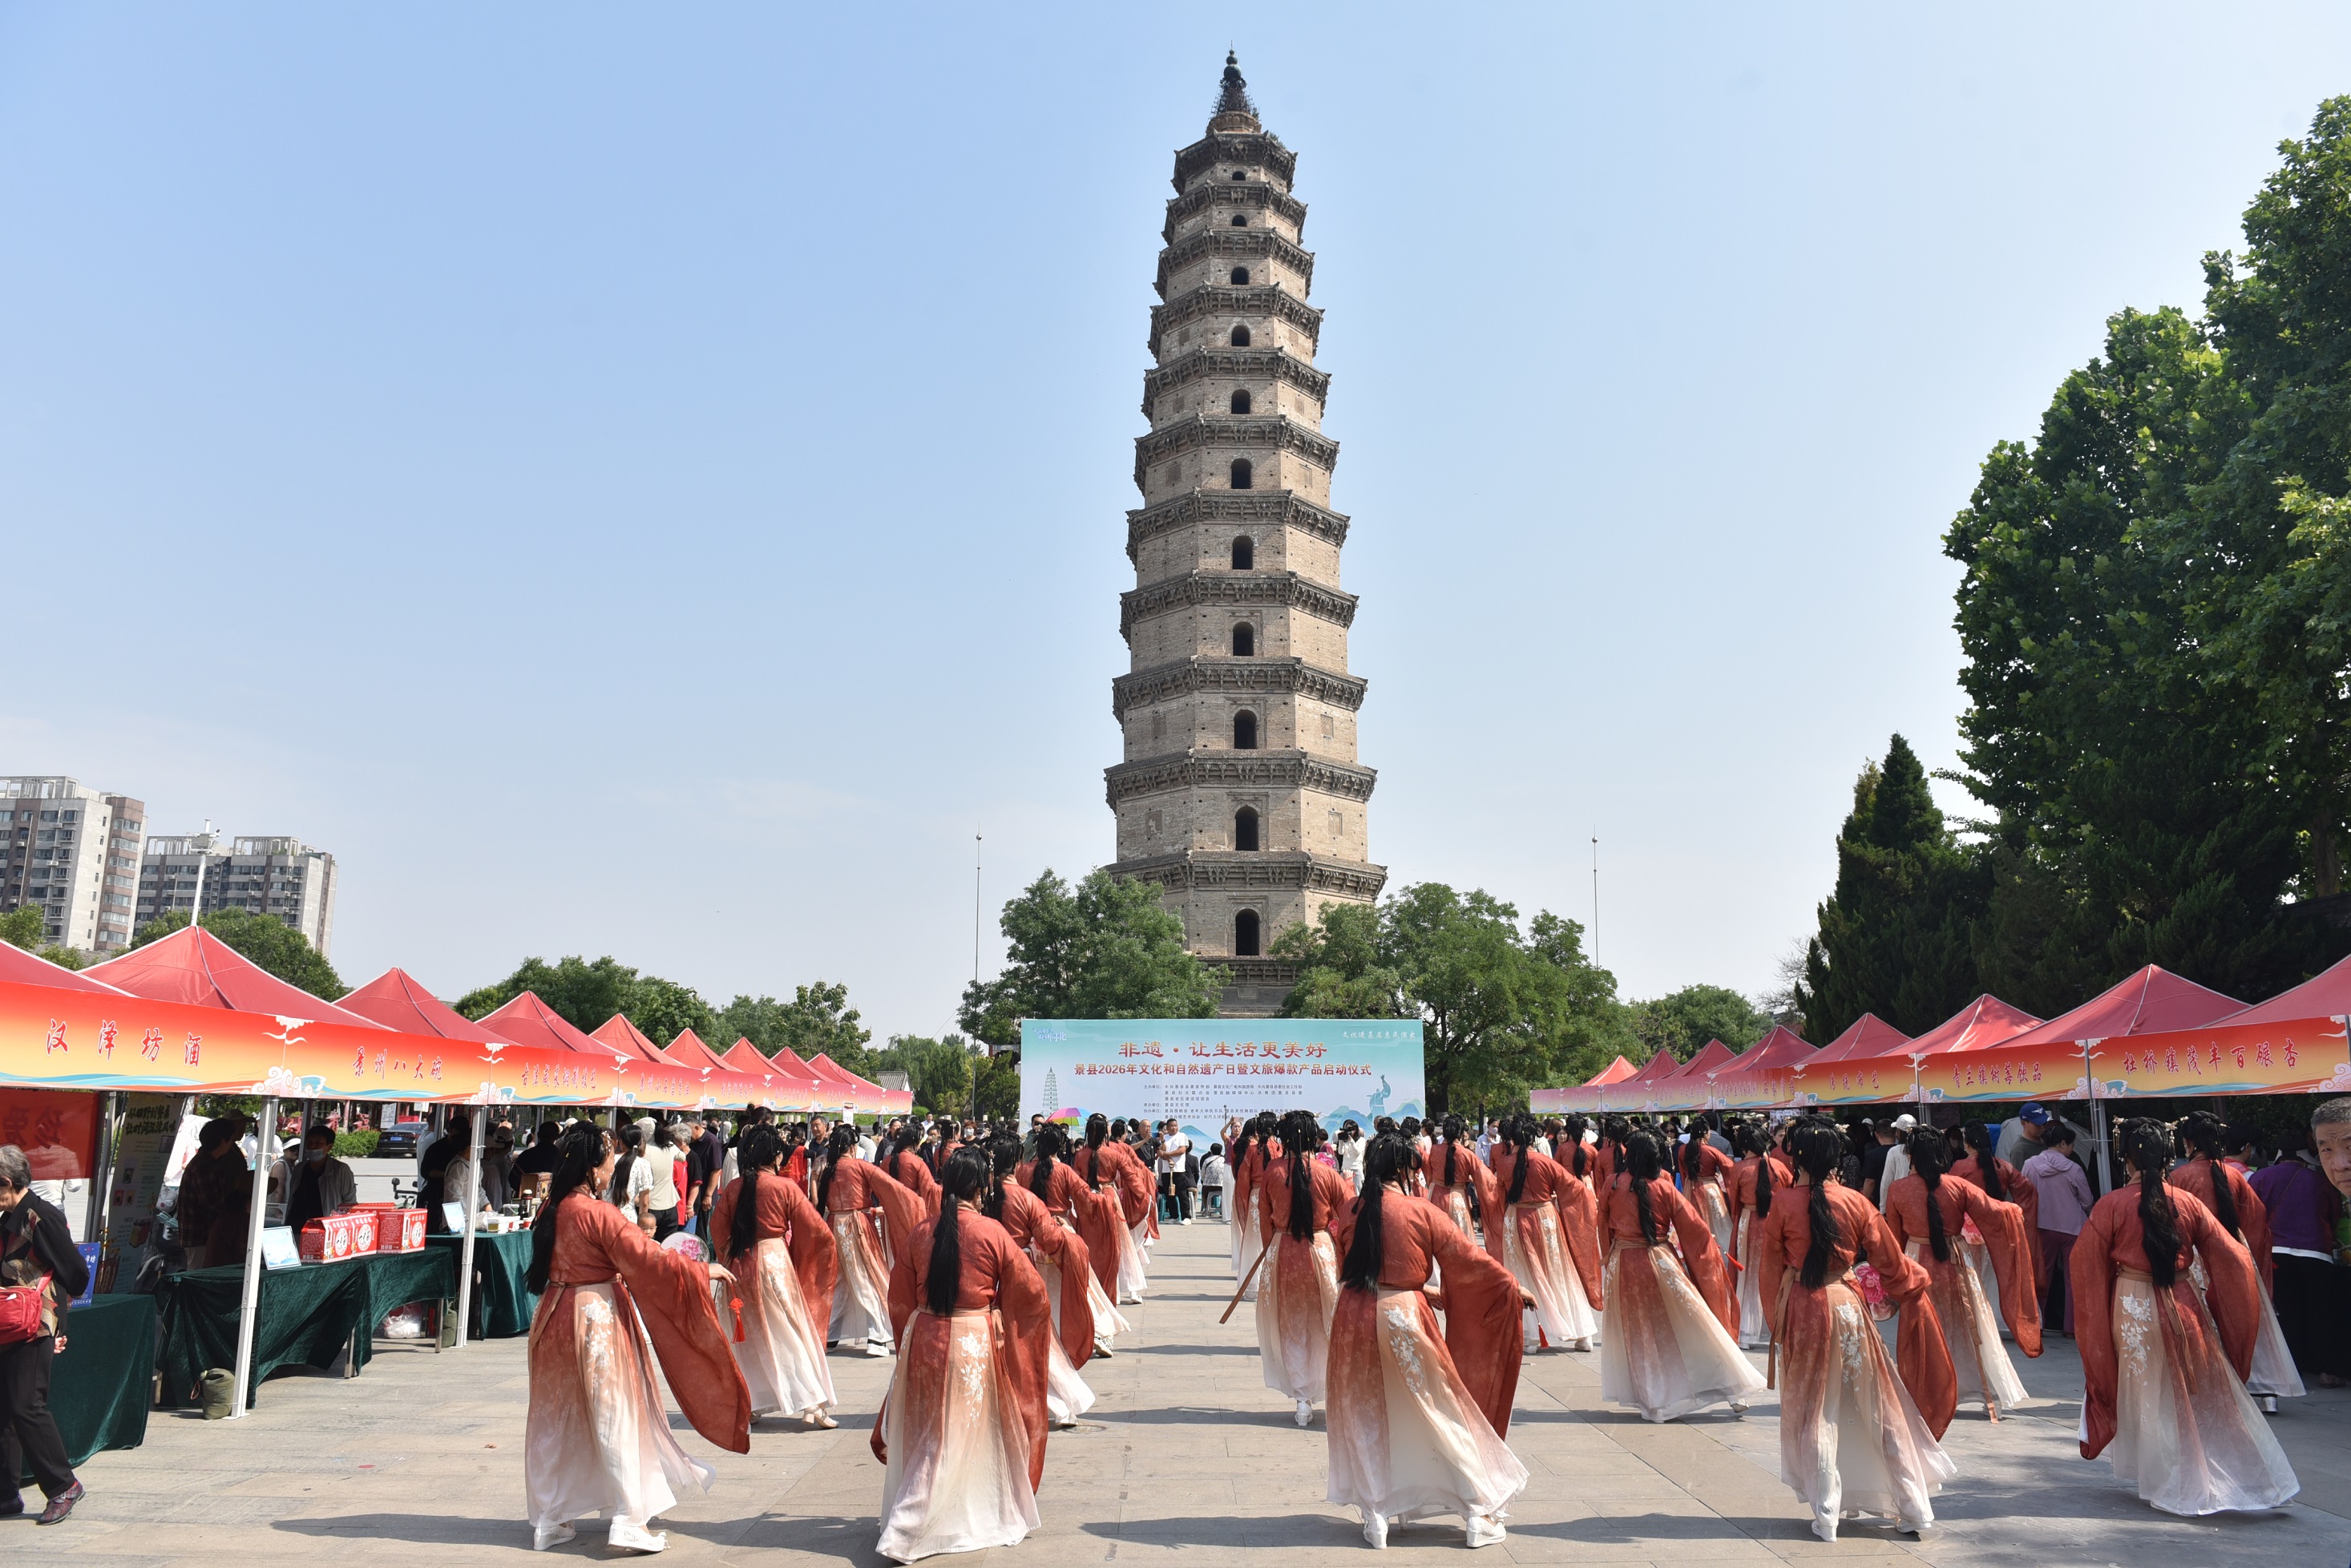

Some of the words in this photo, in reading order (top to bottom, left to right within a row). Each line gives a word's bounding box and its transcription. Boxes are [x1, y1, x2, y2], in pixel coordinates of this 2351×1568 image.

[46, 1018, 202, 1069] 汉泽坊酒
[1342, 1031, 1416, 1039] 文化进基层惠民演出
[353, 1046, 442, 1081] 景州八大碗
[1074, 1063, 1371, 1075] 景县2026年文化和自然遗产日暨文旅爆款产品启动仪式
